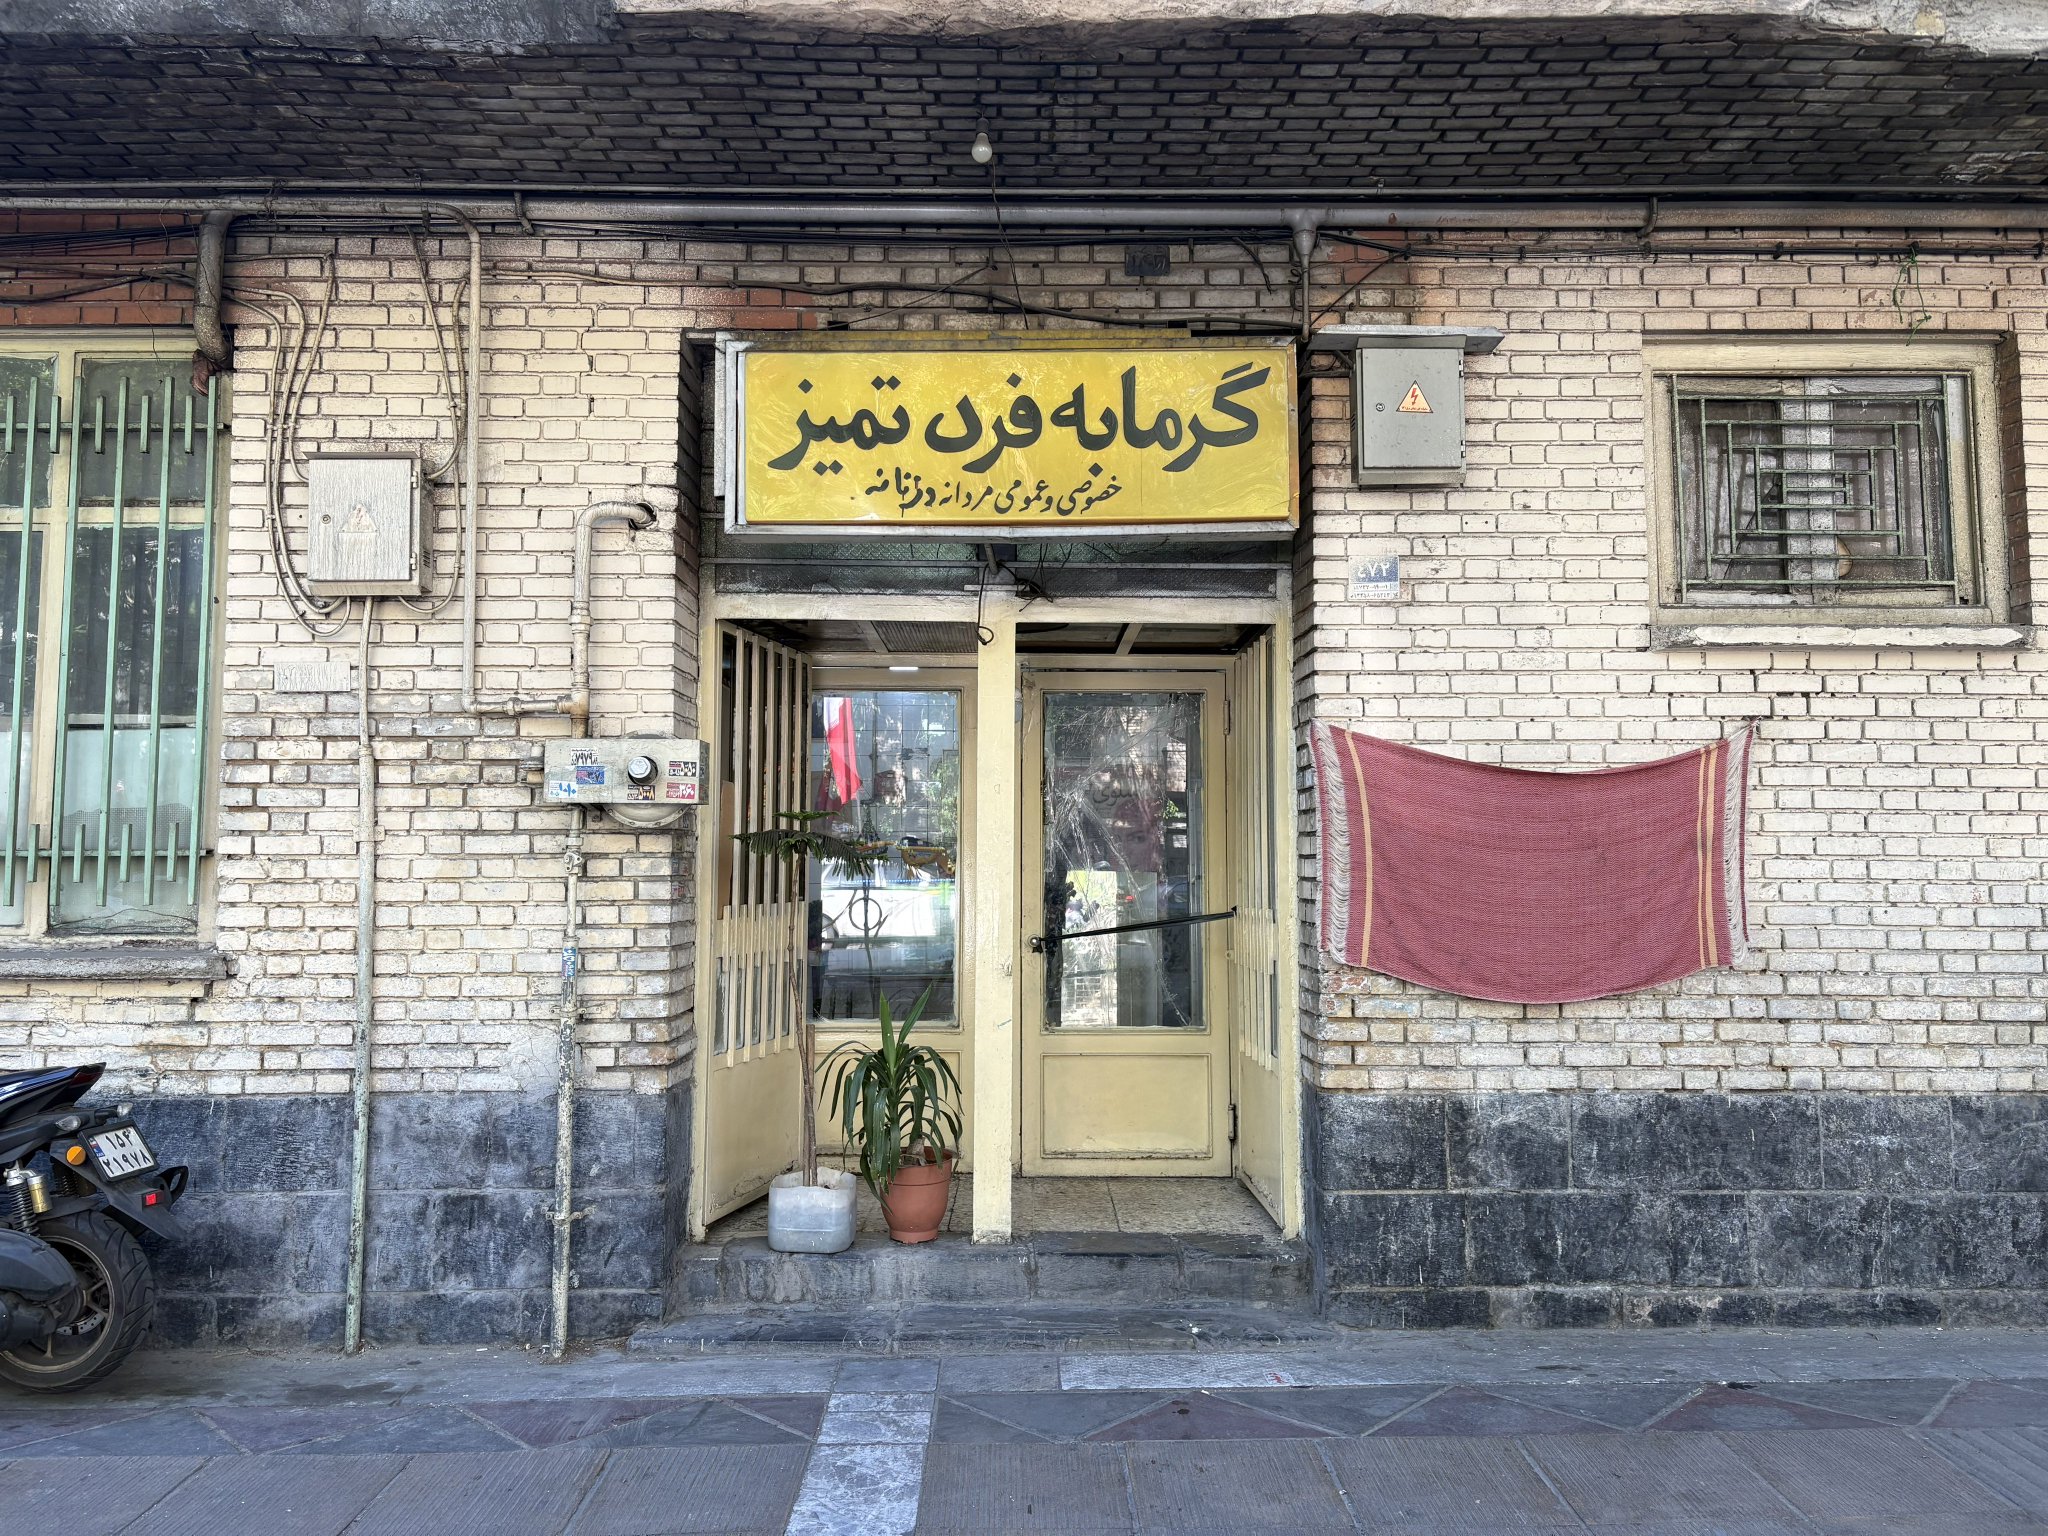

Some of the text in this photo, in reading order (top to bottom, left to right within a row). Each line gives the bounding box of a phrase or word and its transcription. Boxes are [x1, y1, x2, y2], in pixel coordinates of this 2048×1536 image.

[767, 374, 910, 476] تمیز
[1049, 361, 1271, 479] گرمابه
[939, 481, 994, 511] مردانه
[994, 479, 1049, 515] عمومی
[1056, 475, 1122, 516] خصوصی
[105, 1130, 133, 1150] ۱۵۴
[102, 1149, 152, 1175] ۲۱۹۷۸
